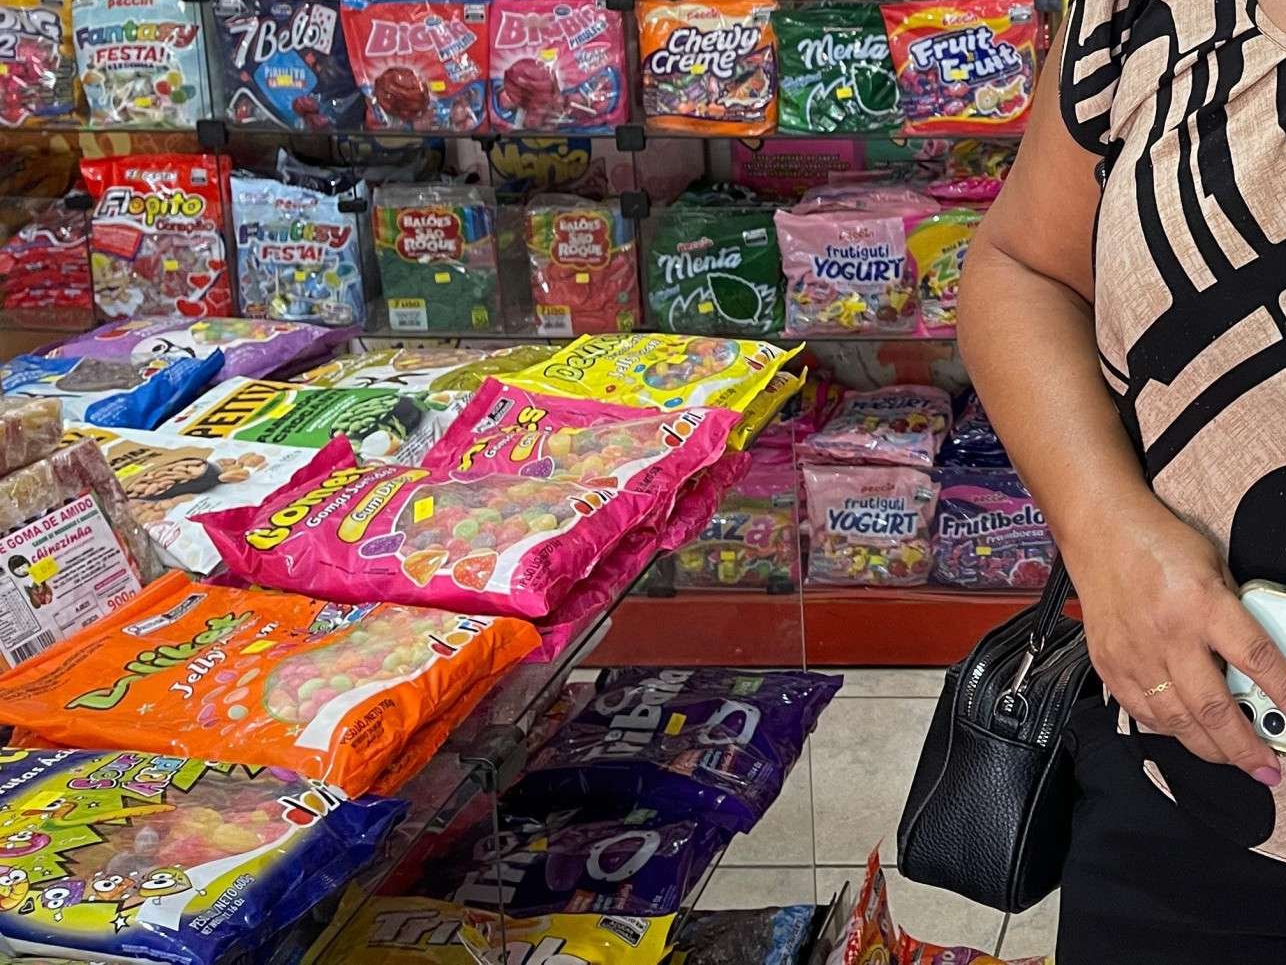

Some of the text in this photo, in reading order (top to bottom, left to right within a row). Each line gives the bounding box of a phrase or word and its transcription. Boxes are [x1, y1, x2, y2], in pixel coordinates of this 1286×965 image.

[76, 23, 198, 47] Fantasy
[229, 12, 320, 67] 7Belo
[667, 27, 762, 58] Chewy
[911, 28, 993, 69] Fruit
[96, 45, 165, 63] FESTA!
[651, 49, 737, 77] Creme
[799, 36, 891, 70] Menta
[938, 46, 1025, 83] Fruit
[98, 189, 206, 223] Flopito
[405, 238, 459, 254] ROQUE
[558, 242, 604, 258] ROQUE
[826, 243, 890, 261] frutiguti
[658, 247, 743, 283] Menta
[814, 256, 905, 282] YOGURT
[661, 410, 703, 448] dori
[306, 490, 351, 527] Gomas
[352, 496, 384, 521] Gum
[844, 497, 906, 513] frutiguti
[7, 498, 93, 549] GOMA DE AMIDO
[828, 510, 920, 537] YOGURT
[427, 615, 493, 657] dori
[169, 649, 228, 699] Jelly
